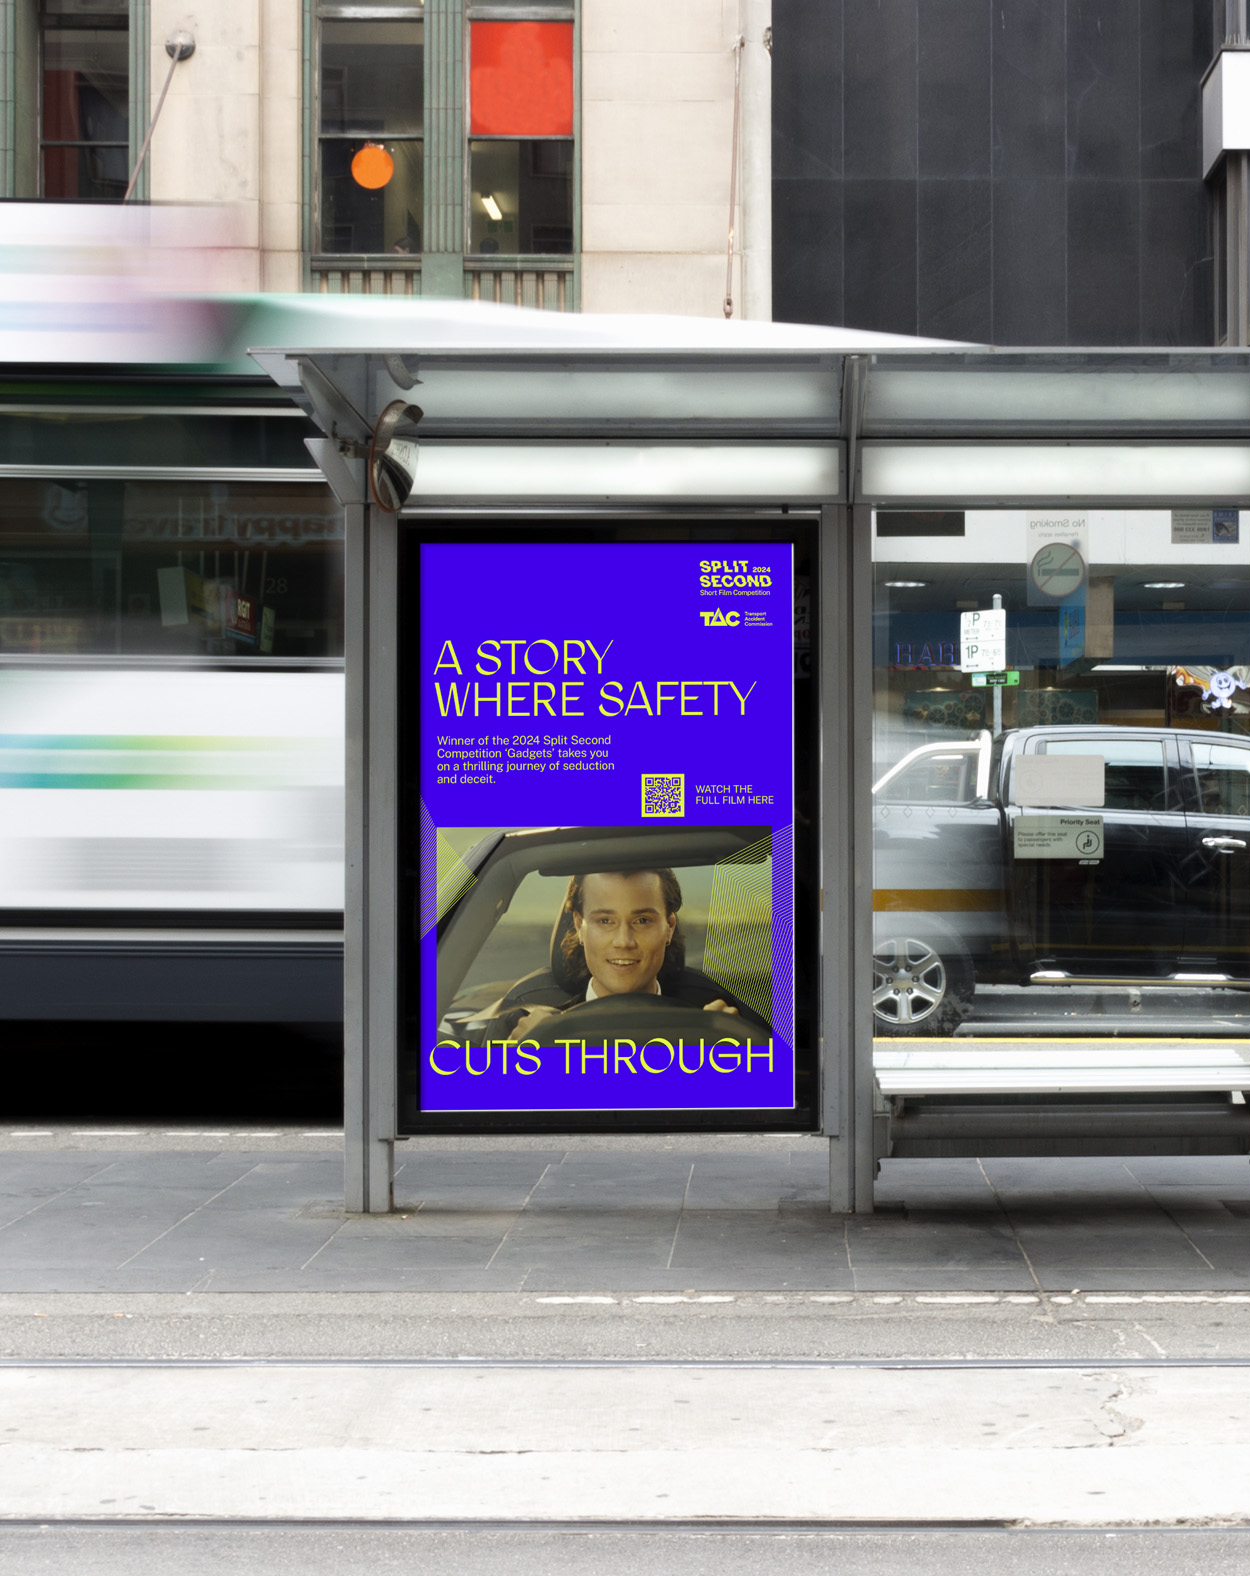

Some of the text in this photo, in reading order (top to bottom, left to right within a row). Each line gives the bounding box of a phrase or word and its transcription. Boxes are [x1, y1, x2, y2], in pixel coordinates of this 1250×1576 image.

[700, 560, 748, 573] SPLIT
[700, 575, 772, 587] SECOND
[732, 589, 771, 597] Competition
[700, 607, 740, 627] TAC
[434, 639, 613, 675] A STORY
[965, 644, 979, 659] 1P
[435, 681, 756, 716] WHERE SAFETY
[437, 735, 610, 746] Winner of the 2024 Split Second
[437, 749, 501, 759] Competition
[558, 748, 586, 757] takes
[590, 750, 608, 759] you
[436, 761, 614, 772] on a thrilling journey of seduction
[437, 774, 495, 784] and deceit.
[696, 785, 752, 793] WATCH THE
[696, 796, 773, 804] FULL FILM HERE
[1060, 818, 1084, 826] Priority
[429, 1037, 772, 1076] CUTS THROUGH
